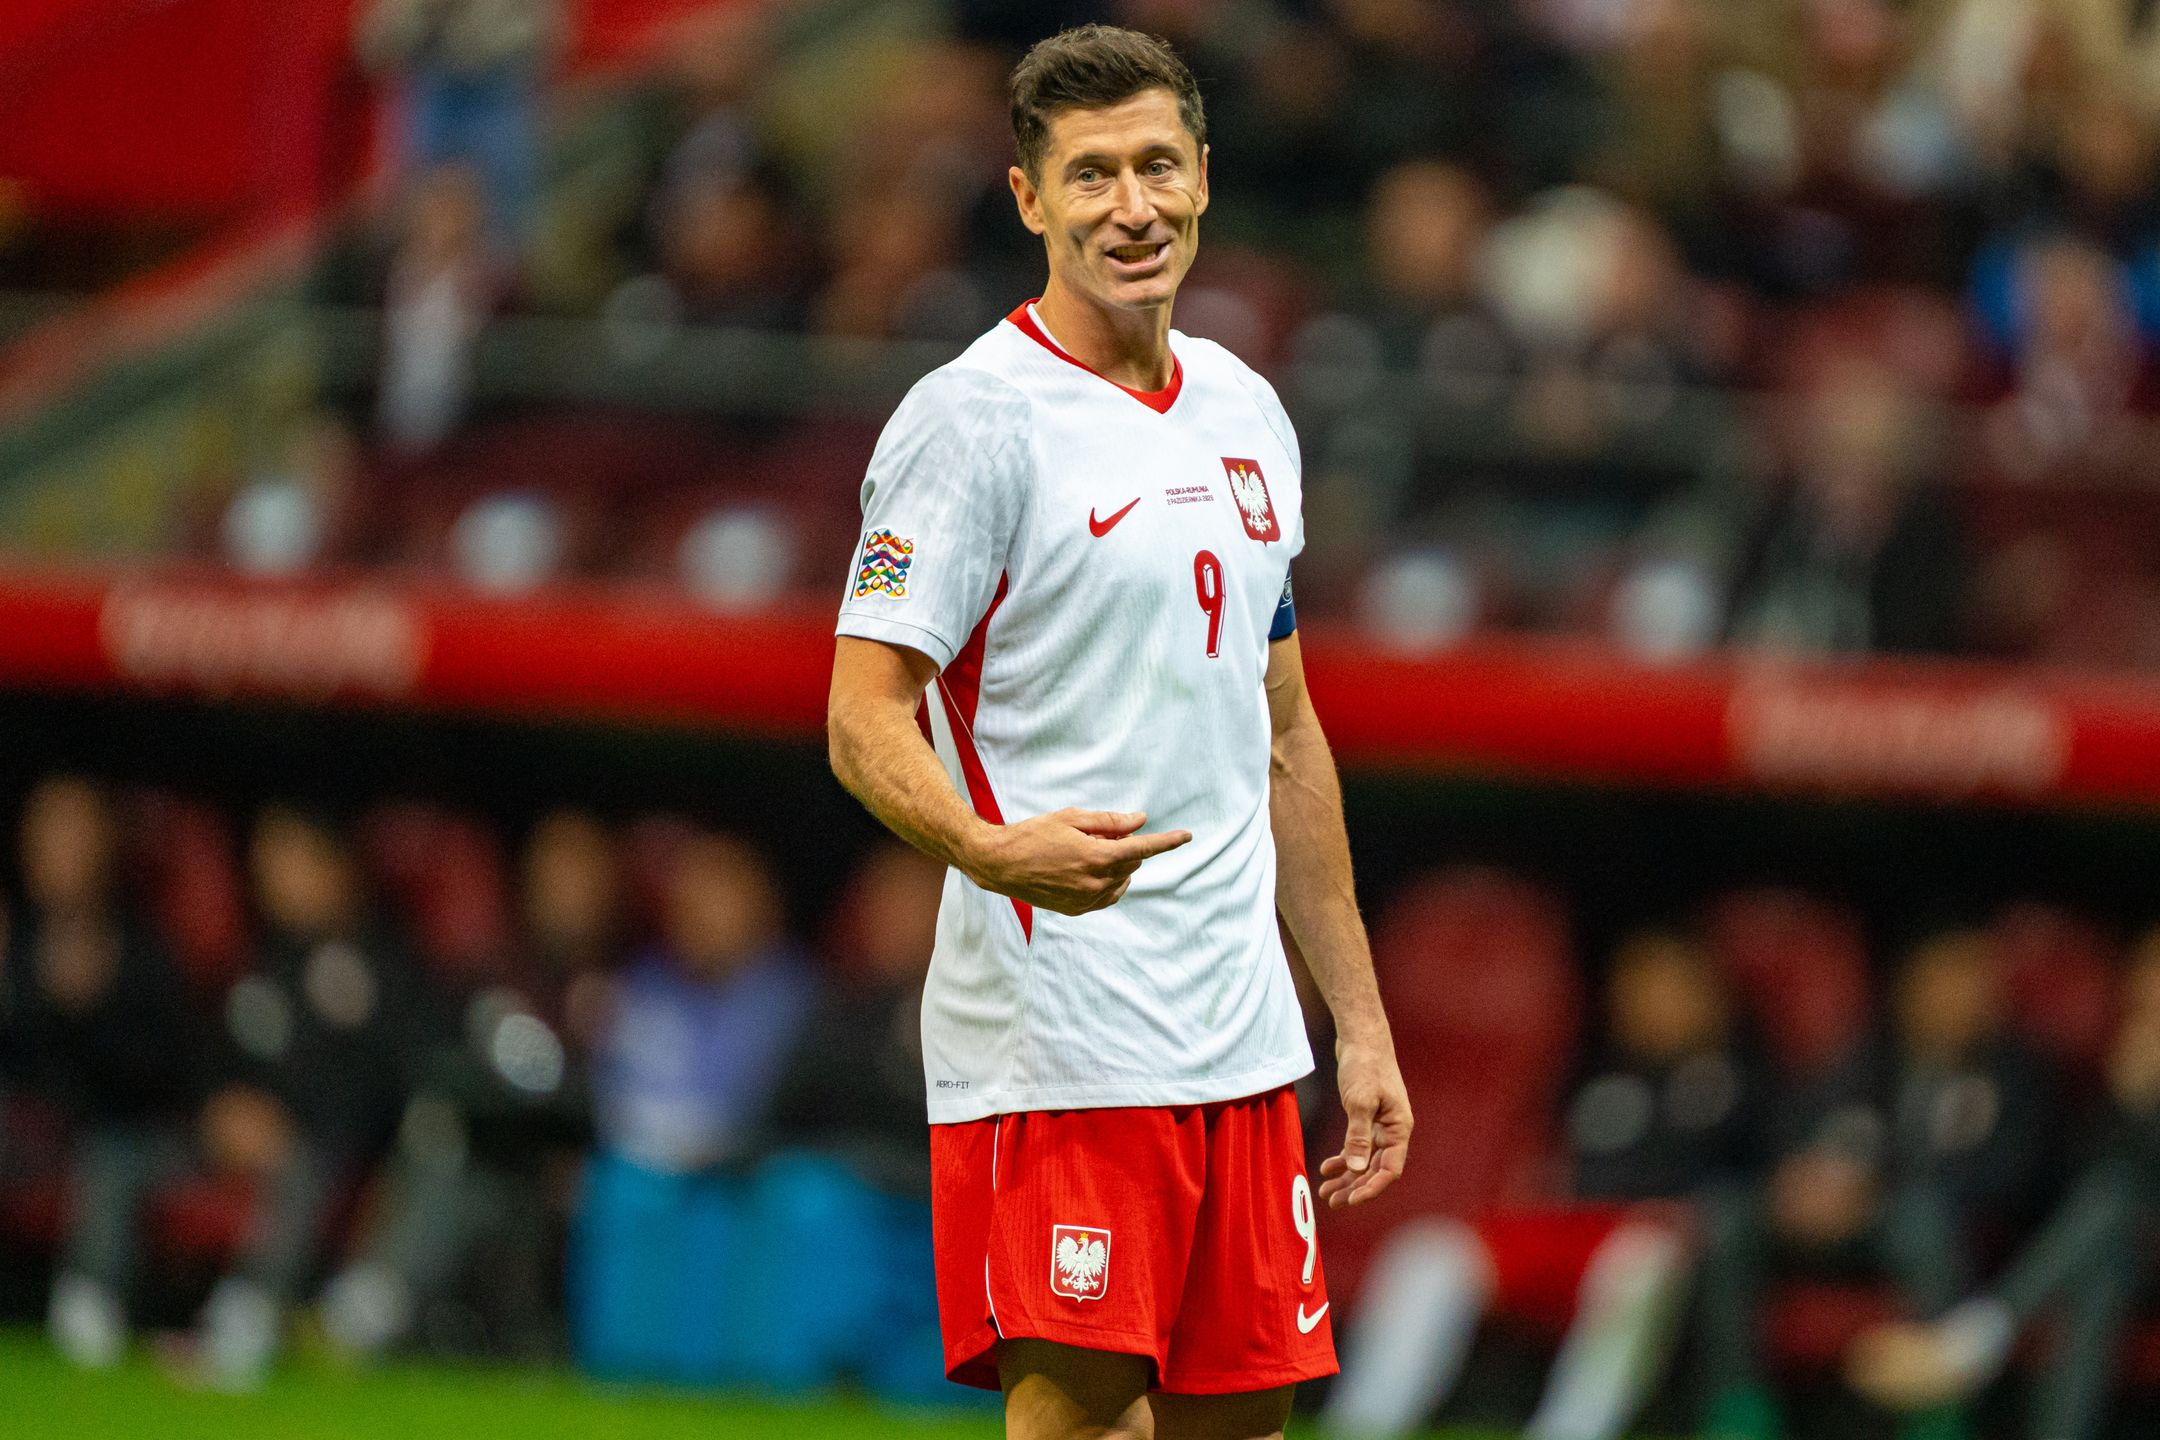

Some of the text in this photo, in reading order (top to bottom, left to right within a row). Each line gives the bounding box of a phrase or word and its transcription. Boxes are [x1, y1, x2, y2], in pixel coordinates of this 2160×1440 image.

[1194, 549, 1226, 658] 9
[936, 1080, 969, 1089] AERO-FIT
[1292, 1174, 1316, 1284] 9
